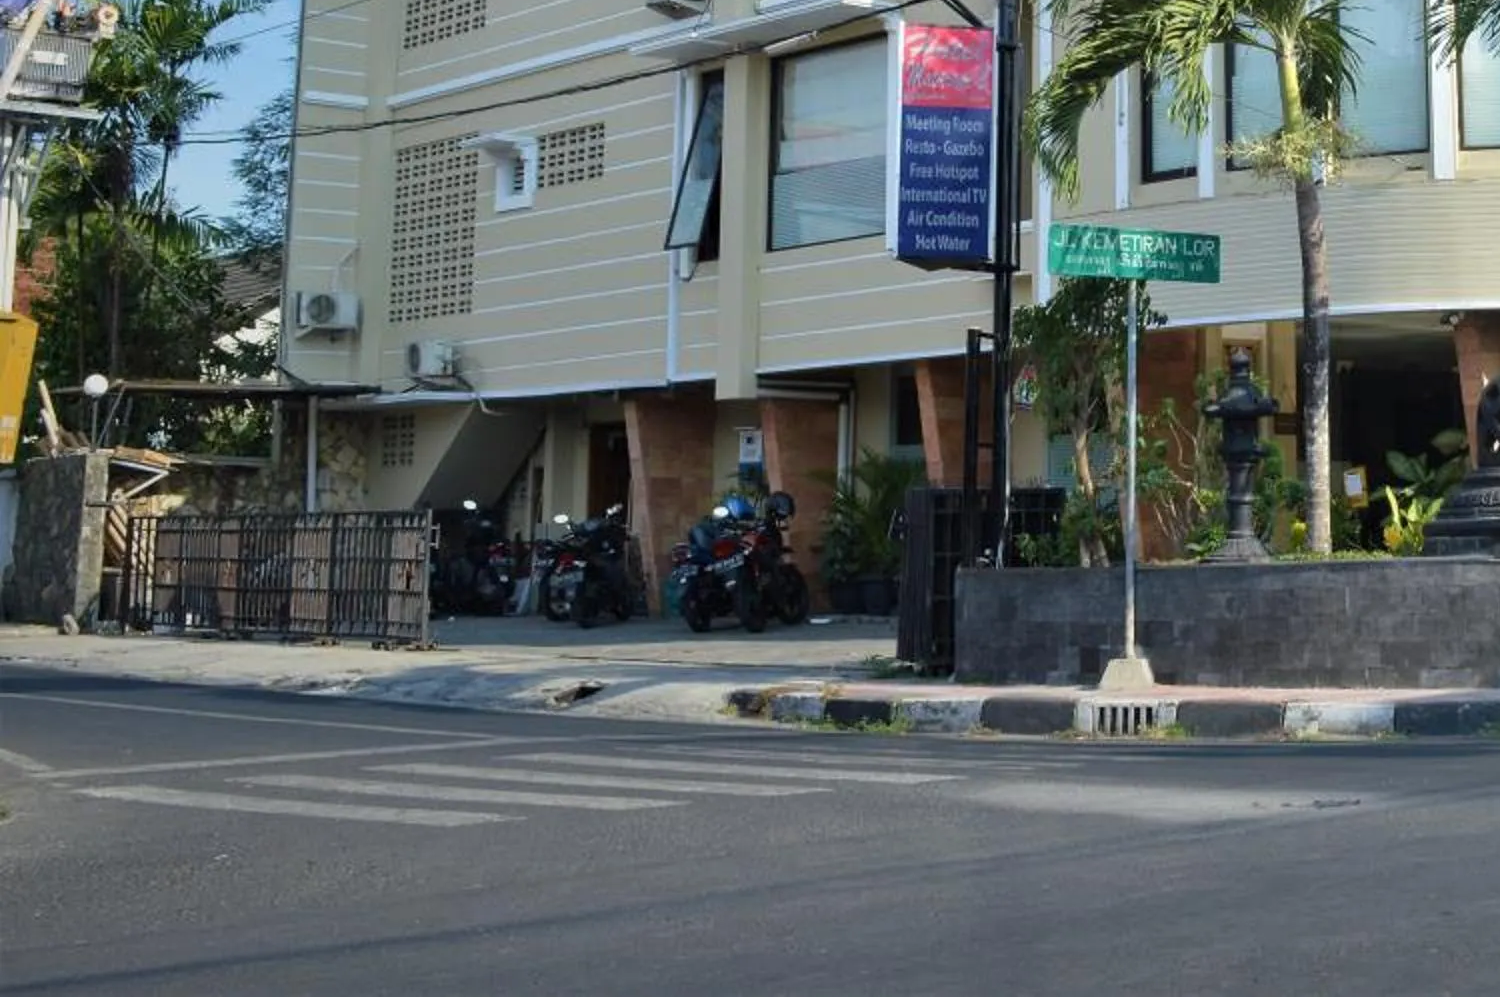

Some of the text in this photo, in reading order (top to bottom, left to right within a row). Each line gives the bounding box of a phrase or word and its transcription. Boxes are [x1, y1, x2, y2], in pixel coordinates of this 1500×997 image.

[904, 114, 984, 135] Meeting Room
[910, 162, 934, 179] Free
[901, 186, 987, 203] International TV
[907, 209, 980, 228] Air Condition
[915, 234, 971, 251] Hot Water
